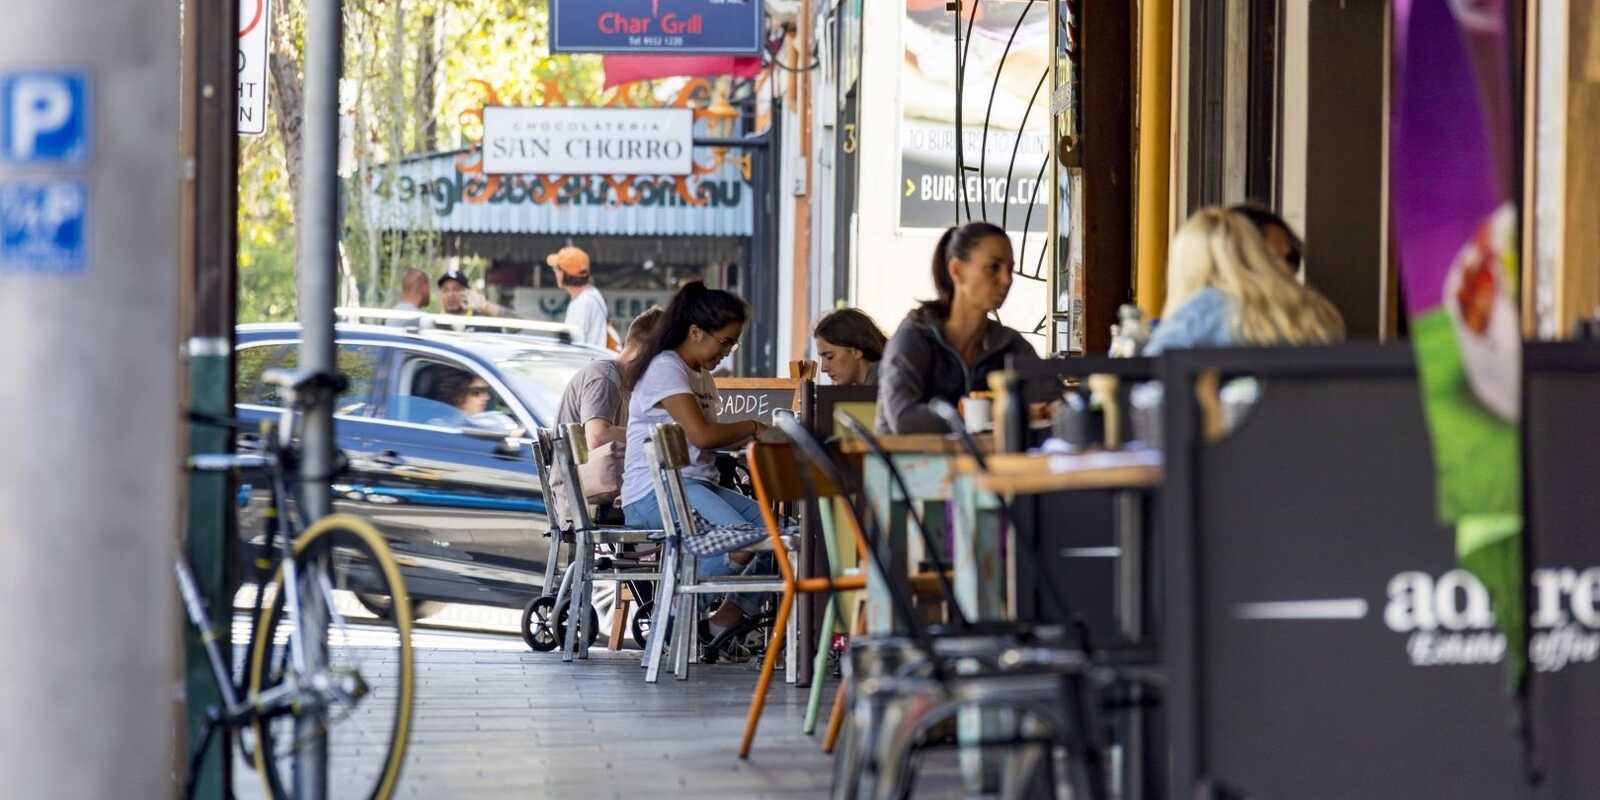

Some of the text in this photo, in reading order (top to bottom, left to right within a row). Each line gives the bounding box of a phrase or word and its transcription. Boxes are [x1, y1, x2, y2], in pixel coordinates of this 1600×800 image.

[597, 12, 703, 35] Char Grill
[11, 77, 73, 157] P
[513, 121, 660, 131] CHOCOLATERIA
[493, 137, 683, 161] SAN CHURRO
[843, 124, 857, 153] 3
